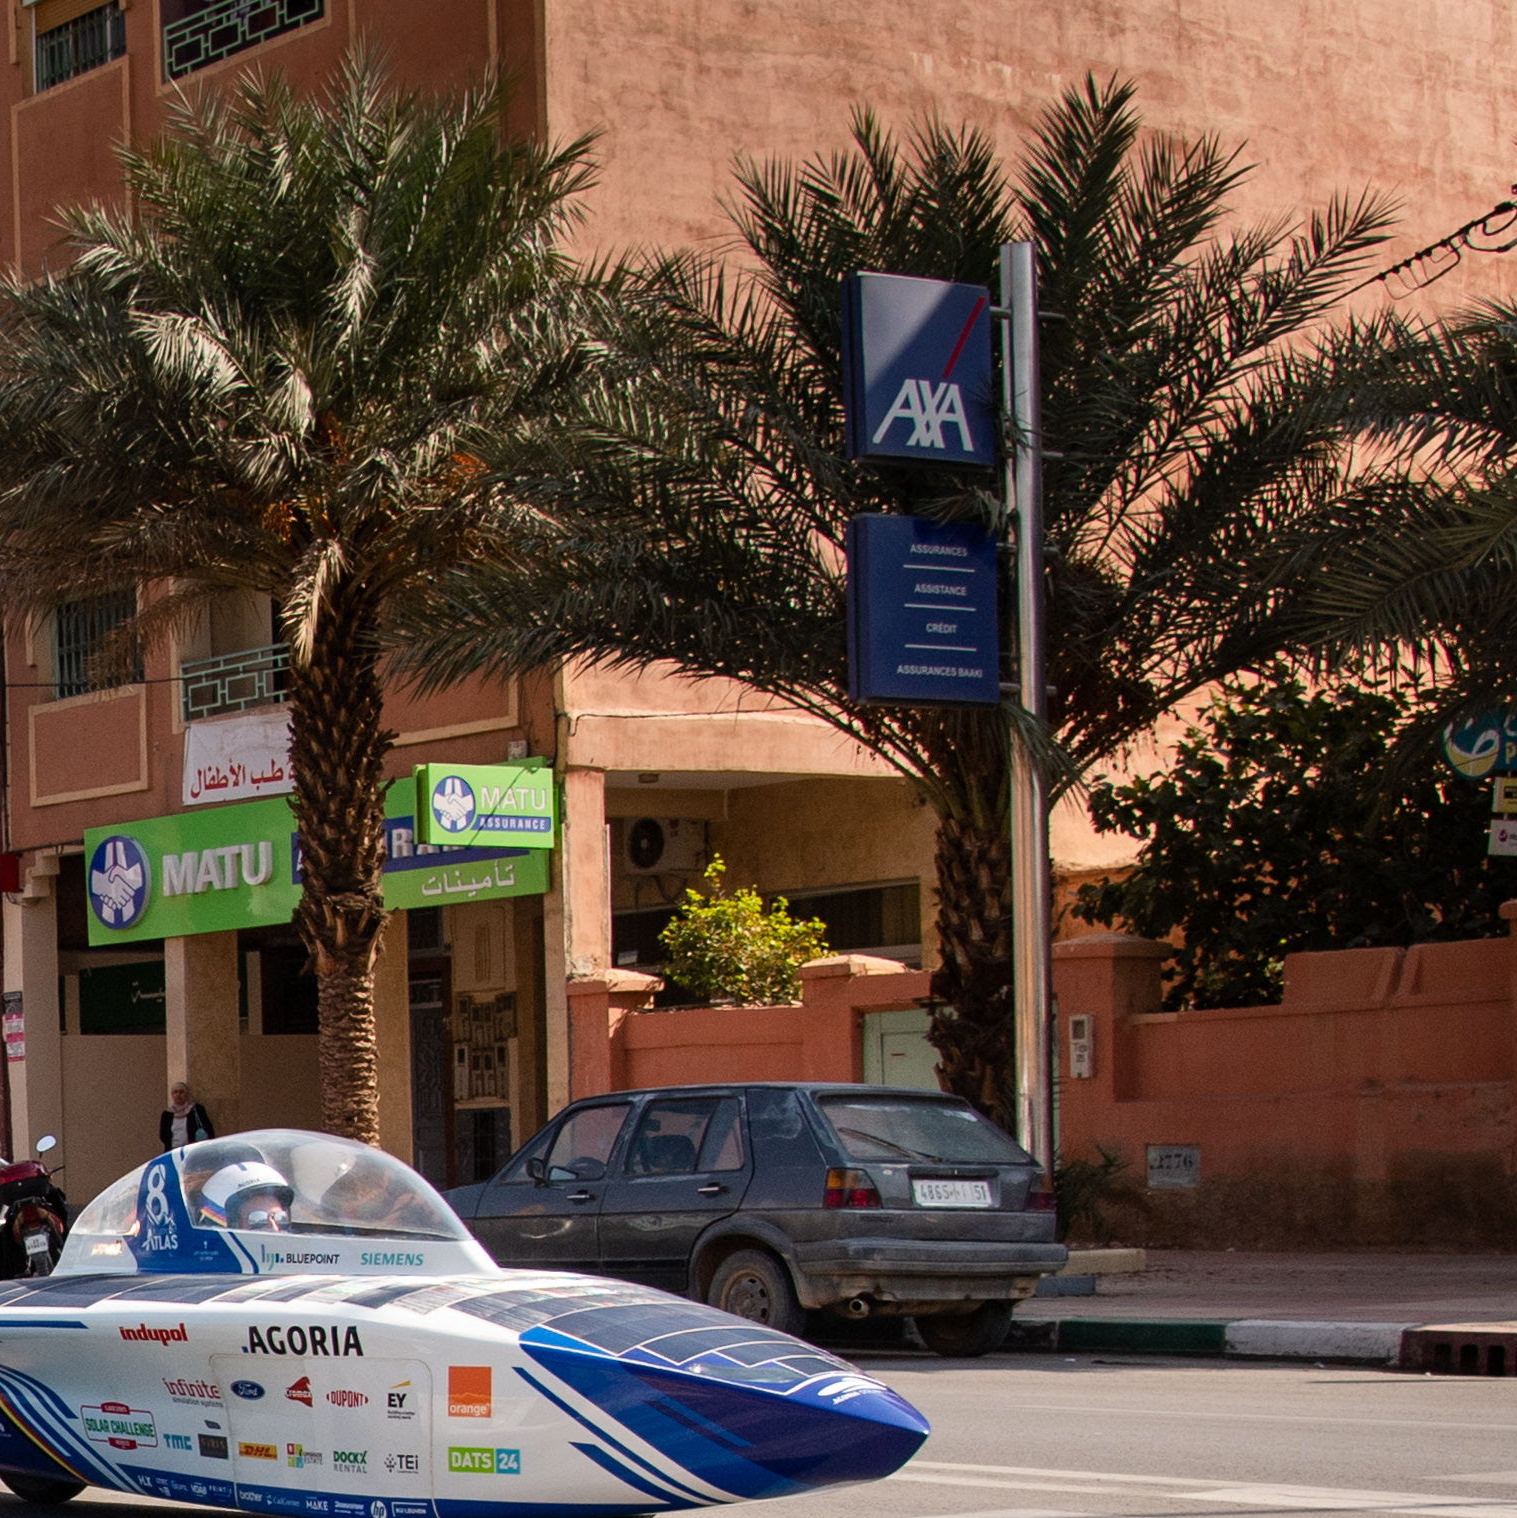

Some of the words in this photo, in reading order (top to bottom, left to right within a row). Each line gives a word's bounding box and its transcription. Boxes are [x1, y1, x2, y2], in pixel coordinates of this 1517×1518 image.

[872, 379, 974, 452] AXA
[910, 544, 968, 557] ASSURANCES
[914, 584, 967, 596] ASSISTANCE
[926, 621, 957, 634] CRÉDIT
[897, 664, 957, 677] ASSURANCES
[190, 758, 246, 799] الأطفال
[480, 786, 547, 811] MATU
[479, 817, 546, 830] ASSURANCE
[163, 841, 272, 896] MATU
[422, 861, 515, 897] تأمينات
[286, 1253, 340, 1264] BLUEPOINT
[360, 1252, 424, 1266] SIEMENS
[119, 1323, 189, 1346] indupol
[162, 1377, 221, 1399] infinite
[330, 1390, 364, 1408] DUPONT
[387, 1393, 407, 1408] EY
[449, 1404, 487, 1416] orange
[85, 1417, 110, 1434] SOLAR
[110, 1420, 156, 1438] CHALLENGE
[243, 1445, 272, 1457] DHL
[333, 1450, 368, 1465] DOCKX
[452, 1452, 492, 1469] DATS
[498, 1453, 518, 1470] 24
[334, 1464, 367, 1474] RENTAL
